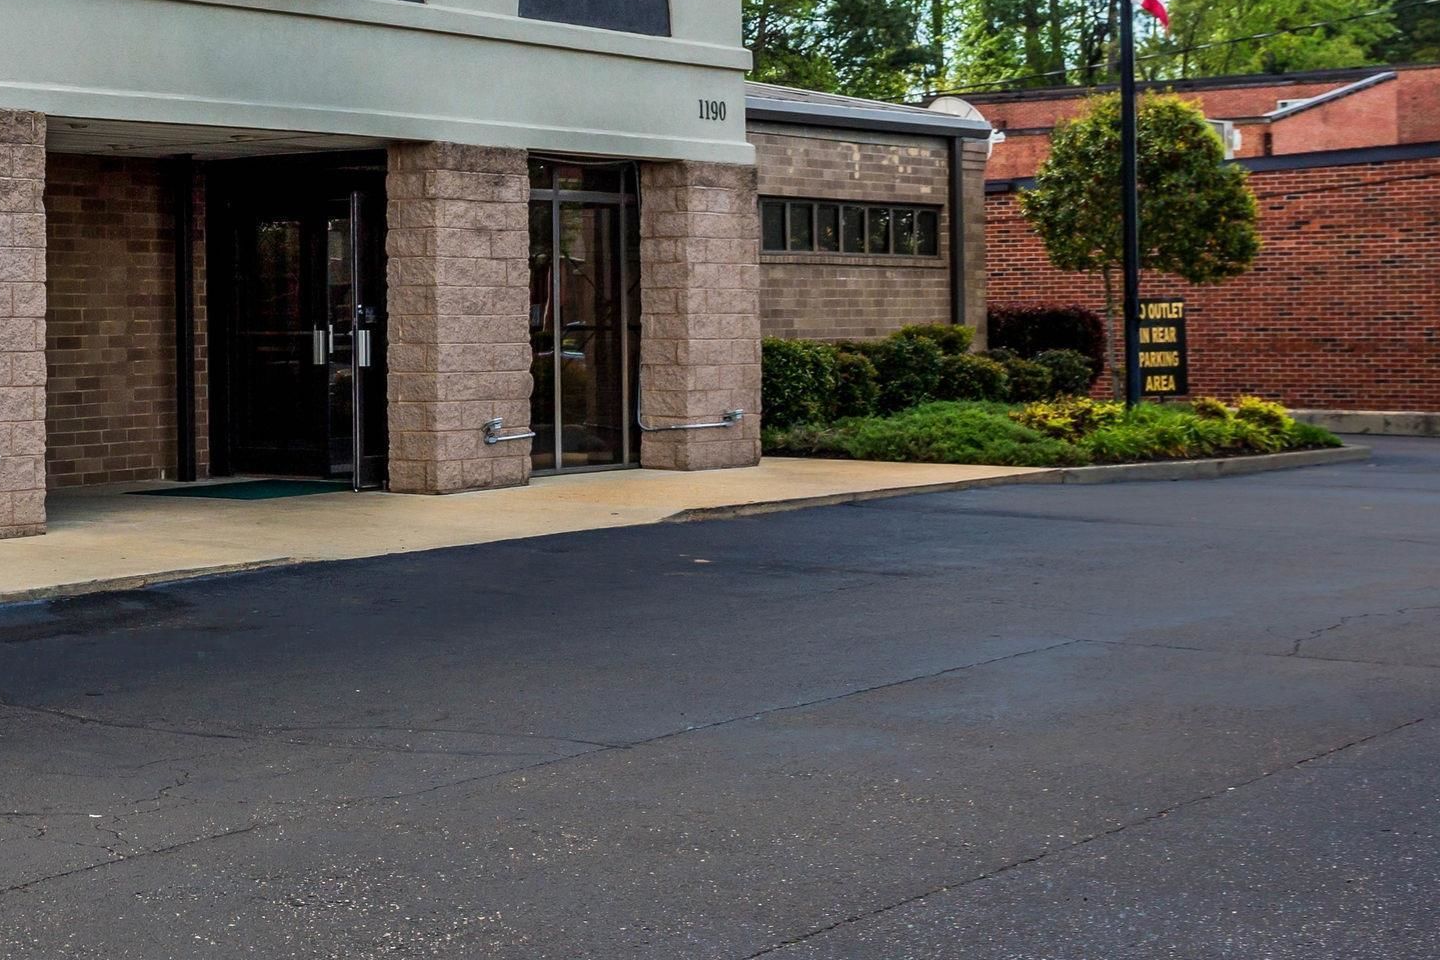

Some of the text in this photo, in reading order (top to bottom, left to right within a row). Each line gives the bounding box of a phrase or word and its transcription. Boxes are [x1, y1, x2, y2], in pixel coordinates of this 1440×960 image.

[698, 99, 726, 121] 1190
[1148, 302, 1183, 319] OUTLET
[1139, 326, 1176, 343] IN REAR
[1138, 351, 1179, 367] PARKING
[1145, 375, 1175, 391] AREA
